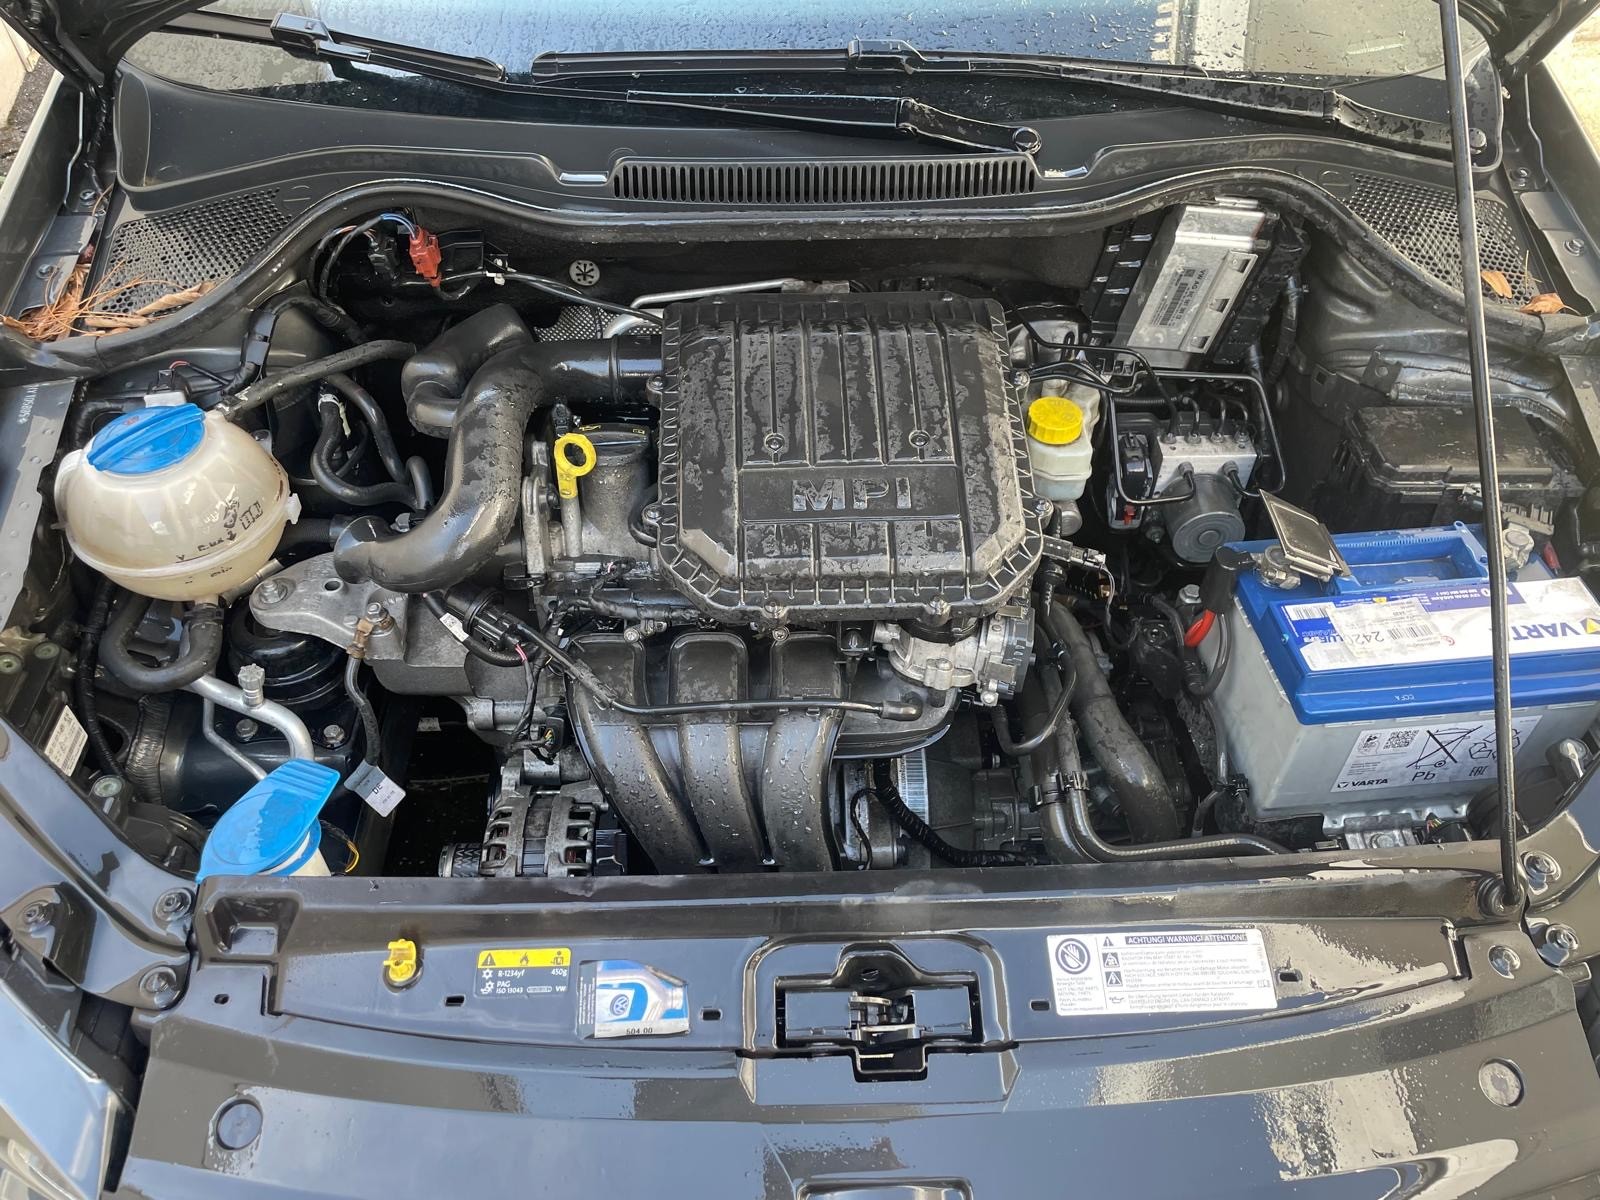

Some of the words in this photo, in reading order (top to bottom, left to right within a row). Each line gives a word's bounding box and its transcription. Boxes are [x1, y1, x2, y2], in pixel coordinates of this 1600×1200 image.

[792, 477, 912, 512] MPI
[1488, 621, 1580, 641] VART
[1351, 777, 1388, 787] VARTA
[1411, 771, 1436, 782] Pb
[1127, 935, 1165, 944] ACHTUNG!
[1166, 934, 1203, 943] WARNING!
[497, 968, 526, 978] R-1234yf
[550, 967, 568, 977] 450g
[495, 986, 507, 994] ISO
[507, 986, 524, 994] 13043
